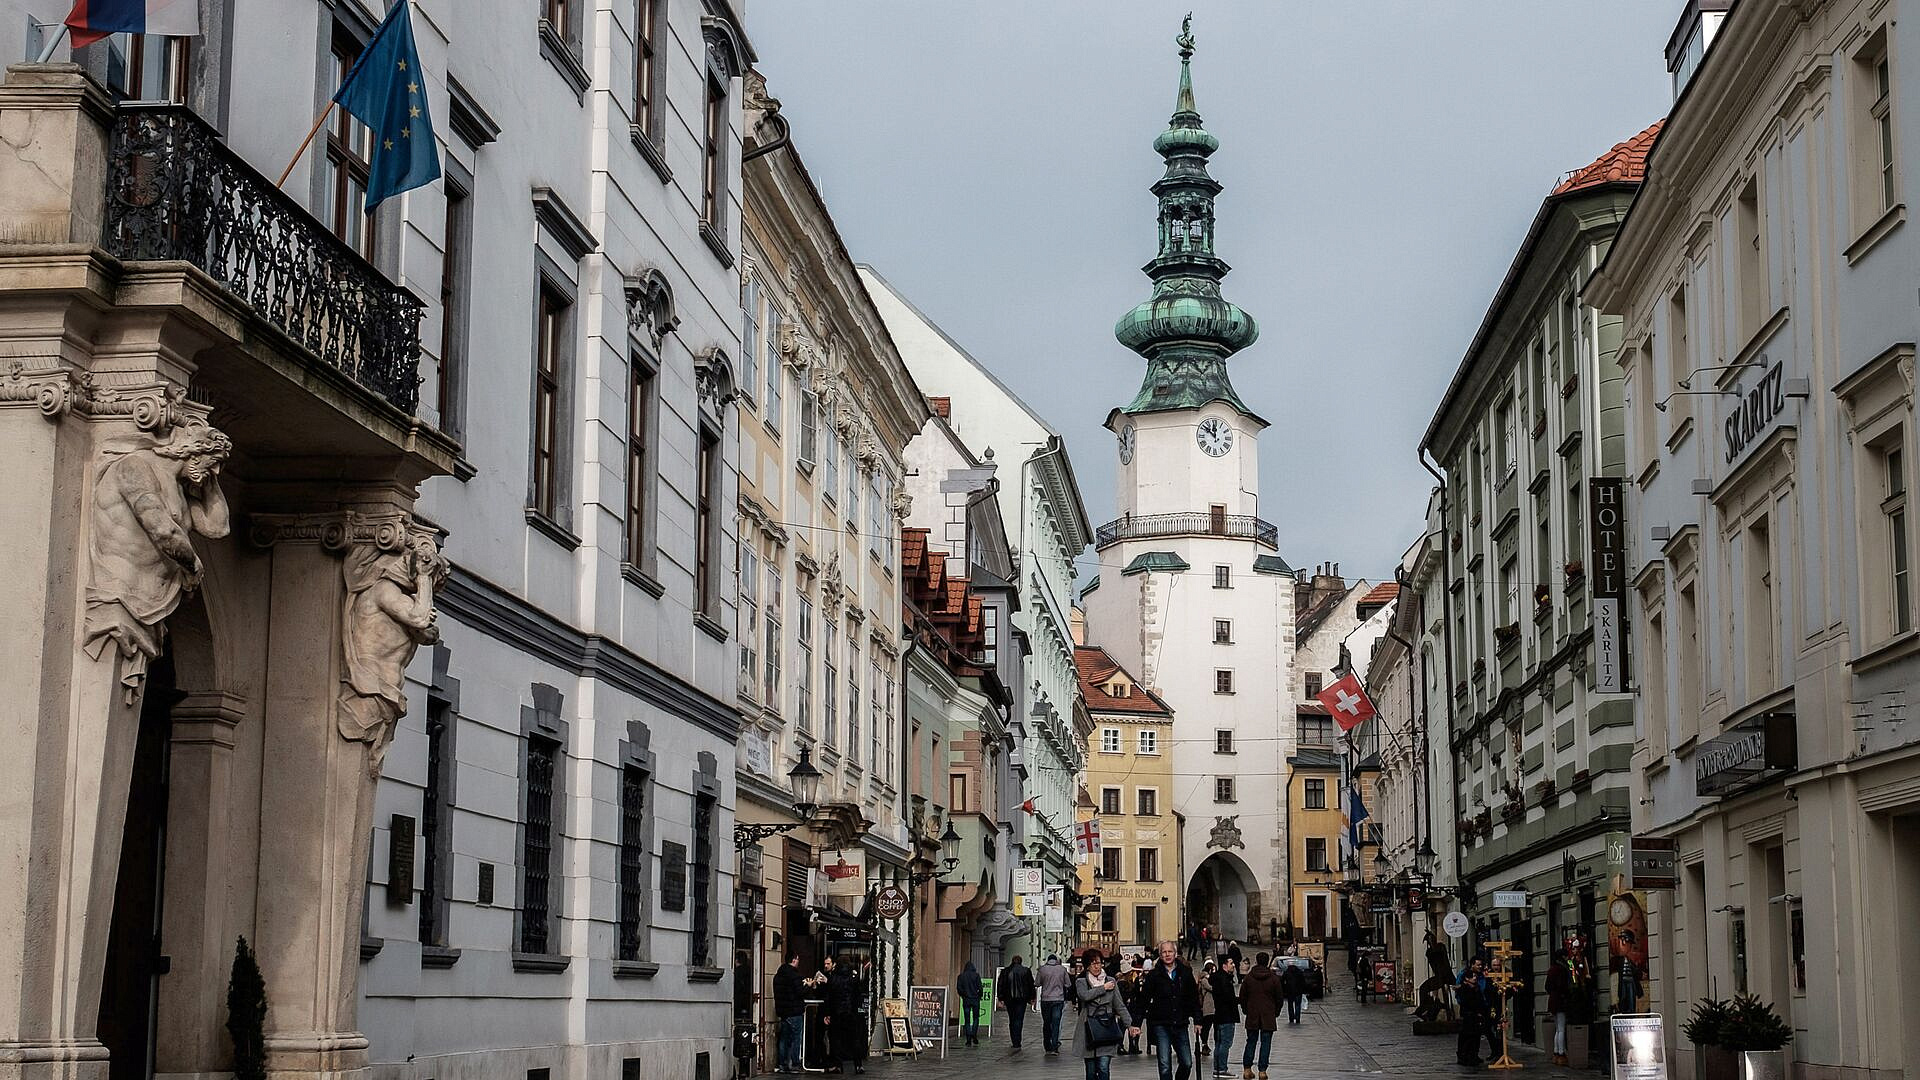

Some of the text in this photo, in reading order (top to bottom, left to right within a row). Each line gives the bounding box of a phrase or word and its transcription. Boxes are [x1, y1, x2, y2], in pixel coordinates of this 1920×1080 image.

[1725, 360, 1785, 464] SKARITZ
[1598, 486, 1618, 593] HOTEL
[1601, 604, 1614, 687] SKARITZ
[1135, 888, 1157, 899] NOVA
[914, 991, 932, 1000] NEW
